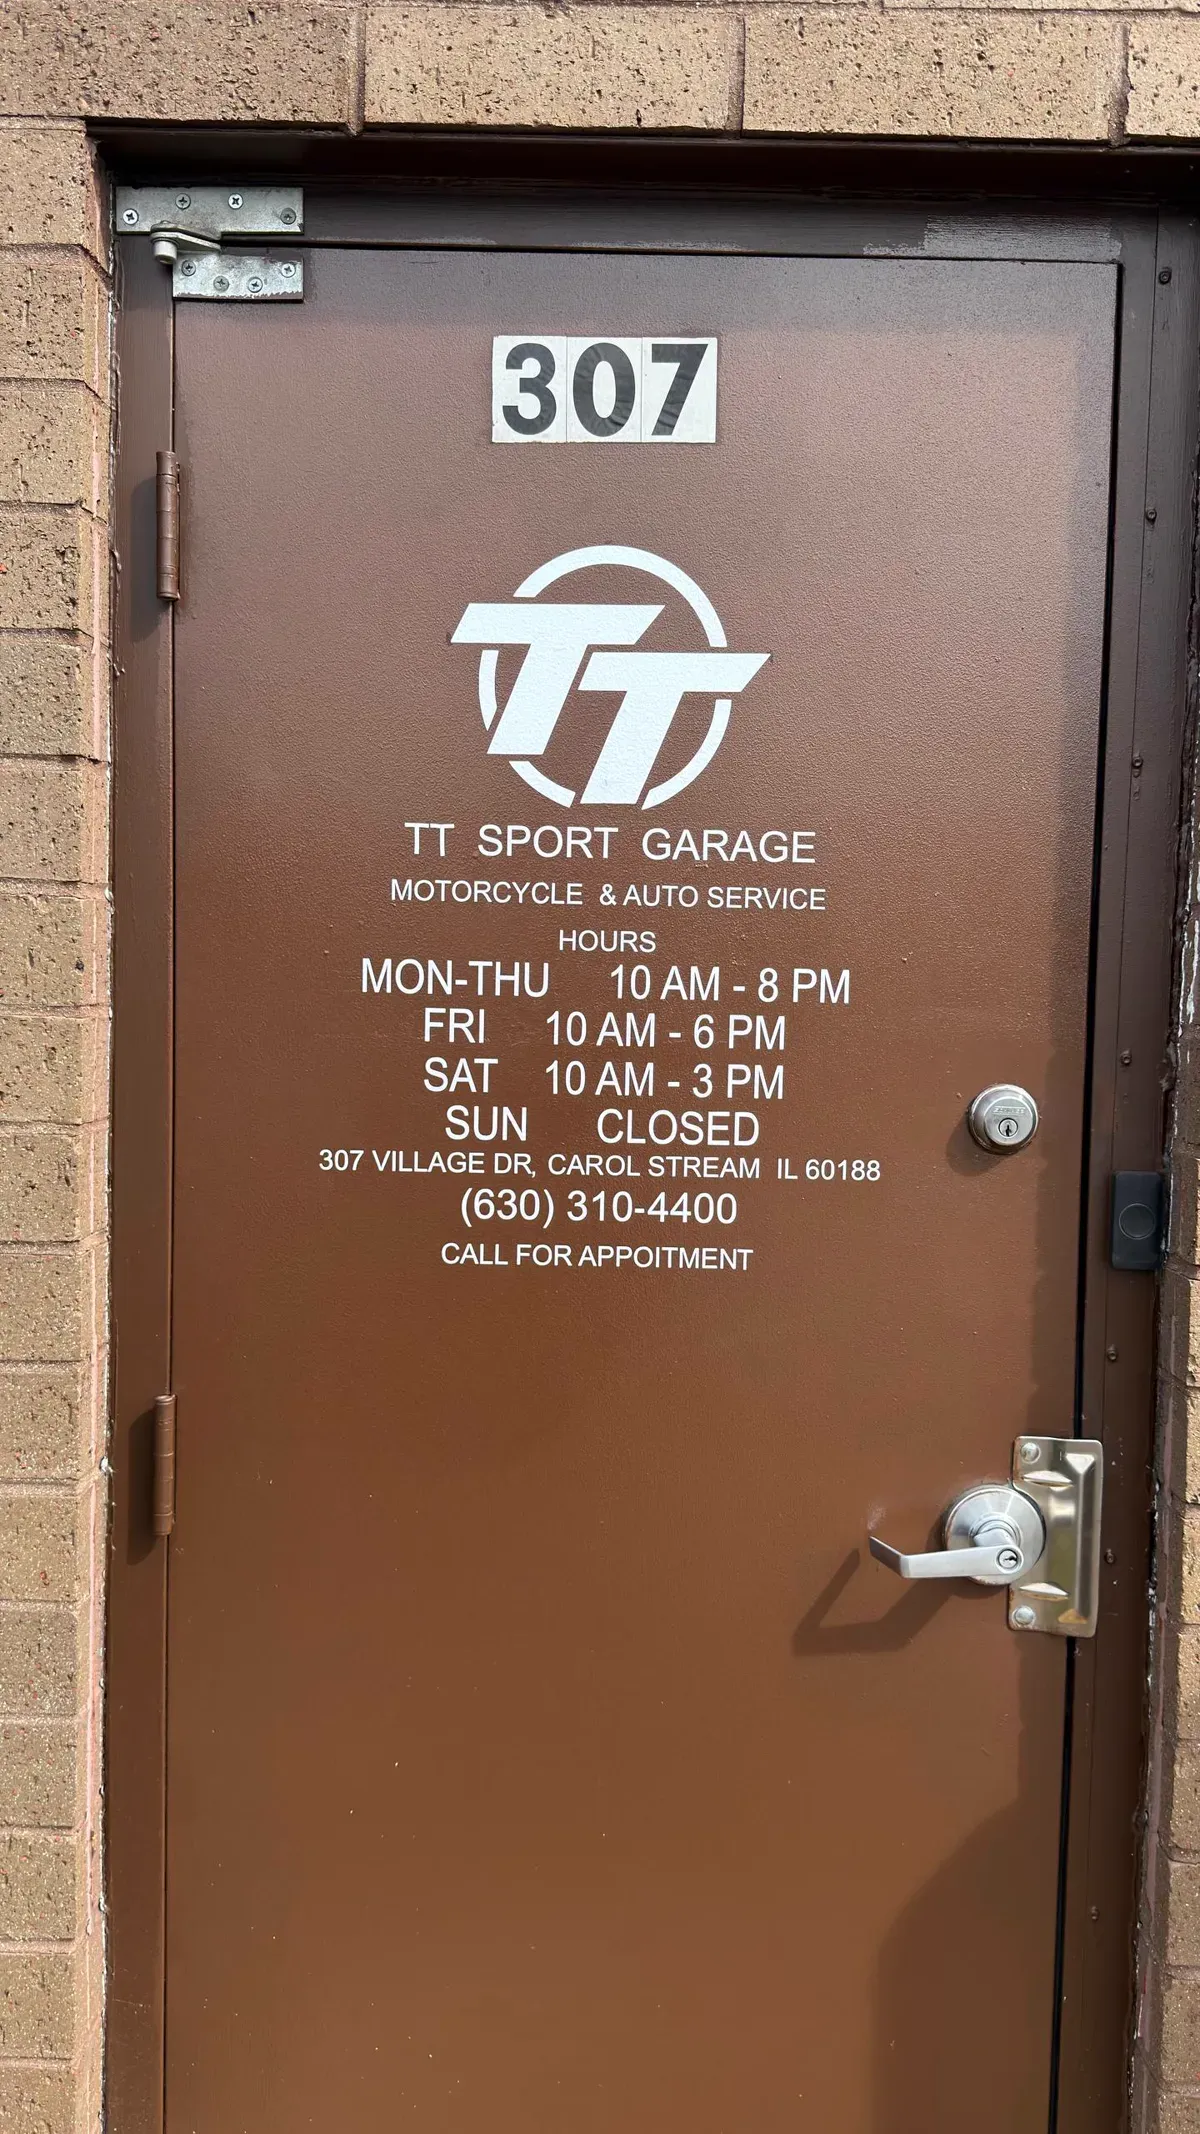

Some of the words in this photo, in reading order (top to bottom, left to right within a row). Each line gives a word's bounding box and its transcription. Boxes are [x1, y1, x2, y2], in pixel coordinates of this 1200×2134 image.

[502, 342, 708, 437] 307
[451, 603, 771, 804] TT
[404, 822, 455, 857] TT
[477, 823, 619, 859] SPORT
[641, 827, 817, 864] GARAGE
[391, 878, 583, 905] MOTORCYCLE
[599, 883, 617, 906] &
[622, 884, 699, 908] AUTO
[707, 886, 826, 911] SERVICE
[559, 929, 657, 953] HOURS
[361, 957, 549, 998] MON-THU
[610, 964, 651, 1000] 10
[659, 965, 720, 1001] AM
[732, 984, 746, 992] -
[757, 967, 779, 1003] 8
[792, 968, 850, 1005] PM
[424, 1007, 485, 1044] FRI
[546, 1010, 587, 1047] 10
[595, 1011, 656, 1048] AM
[668, 1031, 682, 1039] -
[693, 1013, 715, 1049] 6
[728, 1014, 786, 1051] PM
[423, 1056, 499, 1093] SAT
[545, 1059, 586, 1096] 10
[594, 1061, 654, 1097] AM
[667, 1080, 680, 1088] -
[692, 1063, 713, 1099] 3
[727, 1063, 784, 1100] PM
[445, 1104, 527, 1142] SUN
[597, 1108, 760, 1147] CLOSED
[319, 1148, 365, 1171] 307
[371, 1149, 485, 1174] VILLAGE
[494, 1152, 536, 1178] DR,
[548, 1153, 641, 1177] CAROL
[647, 1155, 760, 1179] STREAM
[777, 1158, 798, 1180] IL
[805, 1158, 881, 1182] 60188
[461, 1187, 555, 1229] (630)
[567, 1190, 737, 1225] 310-4400
[441, 1242, 509, 1266] CALL
[516, 1243, 573, 1267] FOR
[577, 1245, 754, 1271] APPOITMENT
